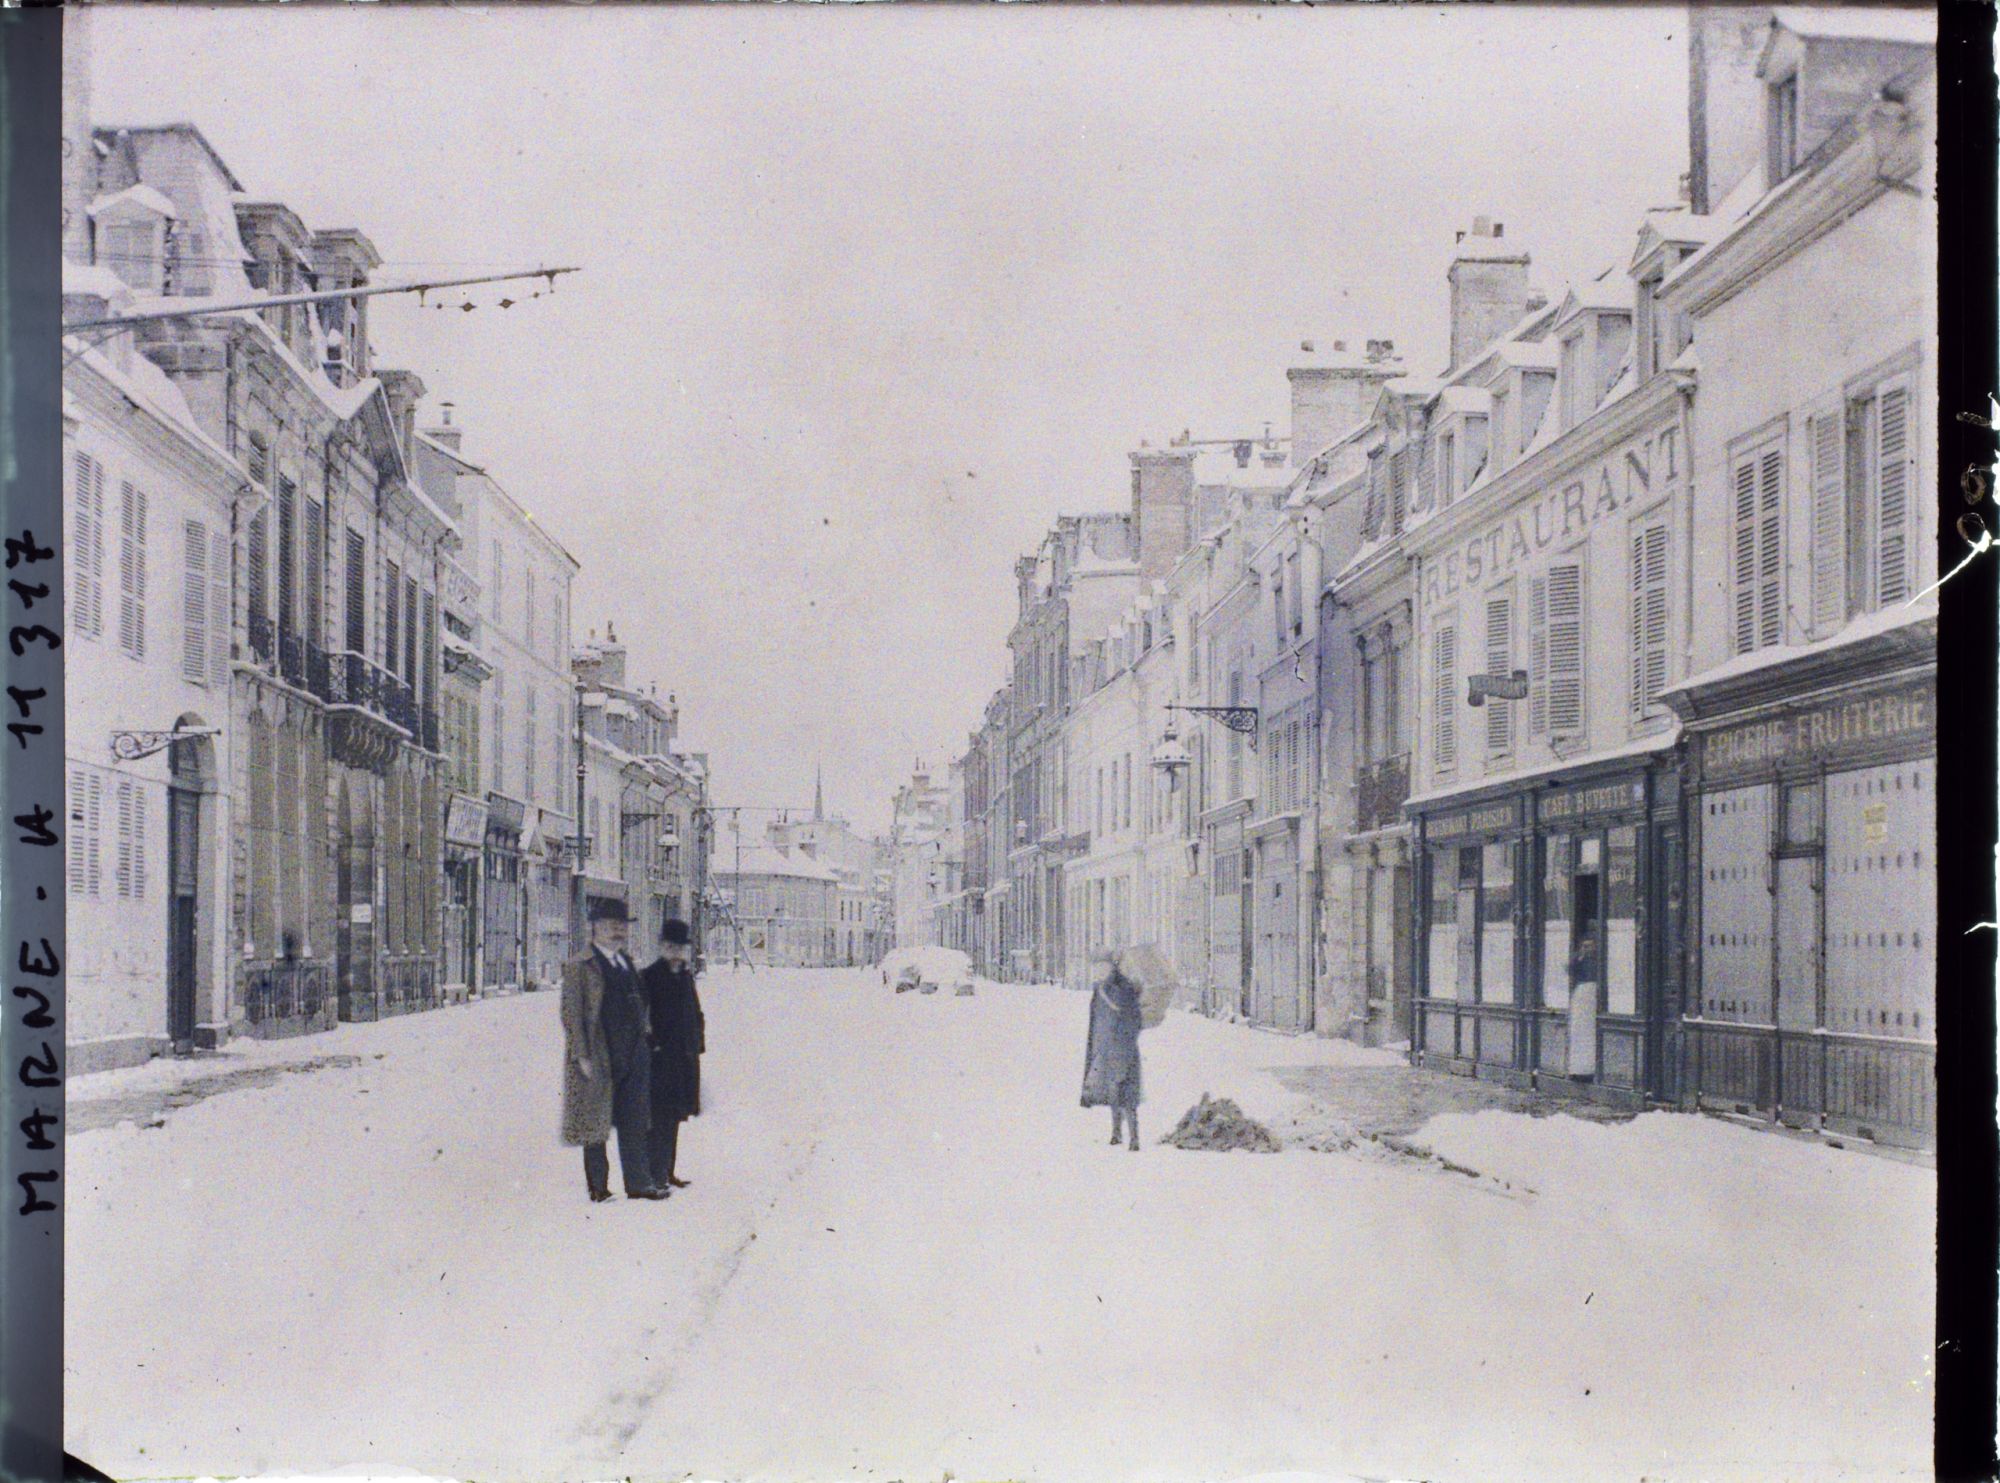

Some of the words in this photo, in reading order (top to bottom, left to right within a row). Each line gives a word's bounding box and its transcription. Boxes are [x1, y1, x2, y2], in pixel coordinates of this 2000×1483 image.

[1424, 426, 1679, 606] RESTAURANT
[1797, 688, 1928, 750] FRUITERIE
[13, 938, 61, 1216] MARNE
